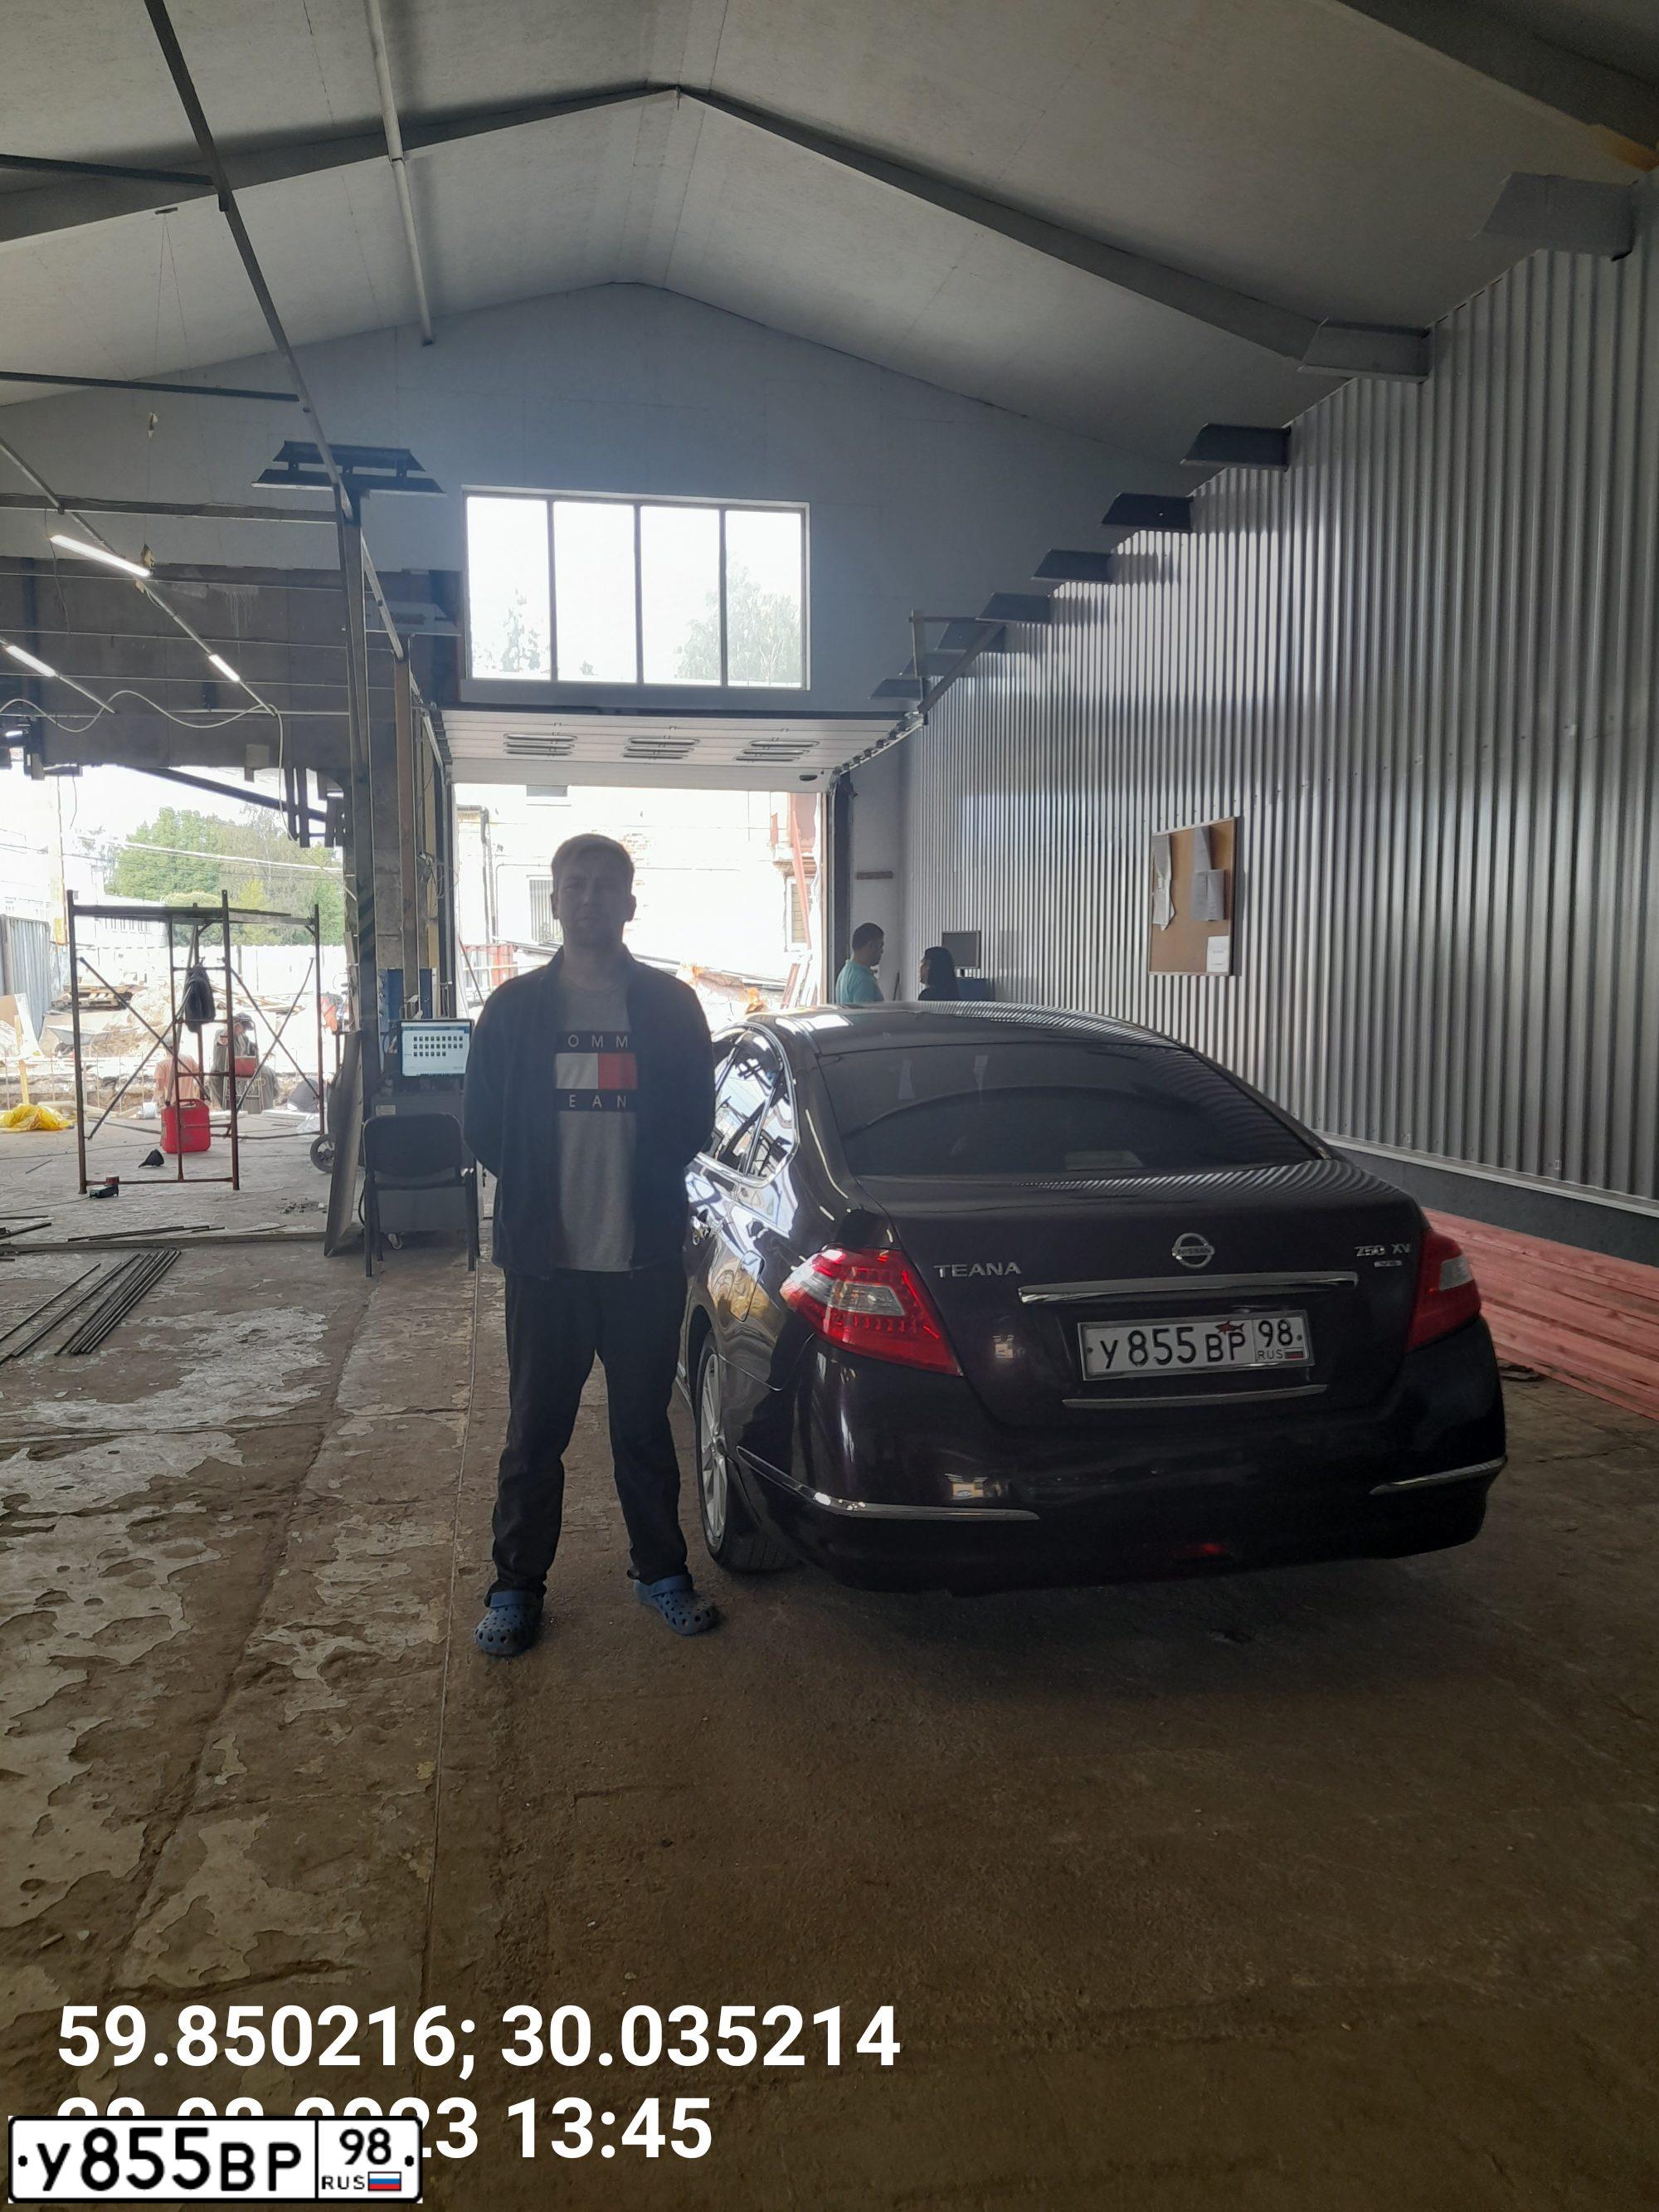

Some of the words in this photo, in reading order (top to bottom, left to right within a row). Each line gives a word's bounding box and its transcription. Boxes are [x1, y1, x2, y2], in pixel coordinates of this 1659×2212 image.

[567, 1034, 629, 1048] OMM
[568, 1094, 627, 1108] EAN
[933, 1261, 1022, 1279] TEANA
[1258, 1319, 1293, 1347] 98
[1258, 1349, 1284, 1361] RUS
